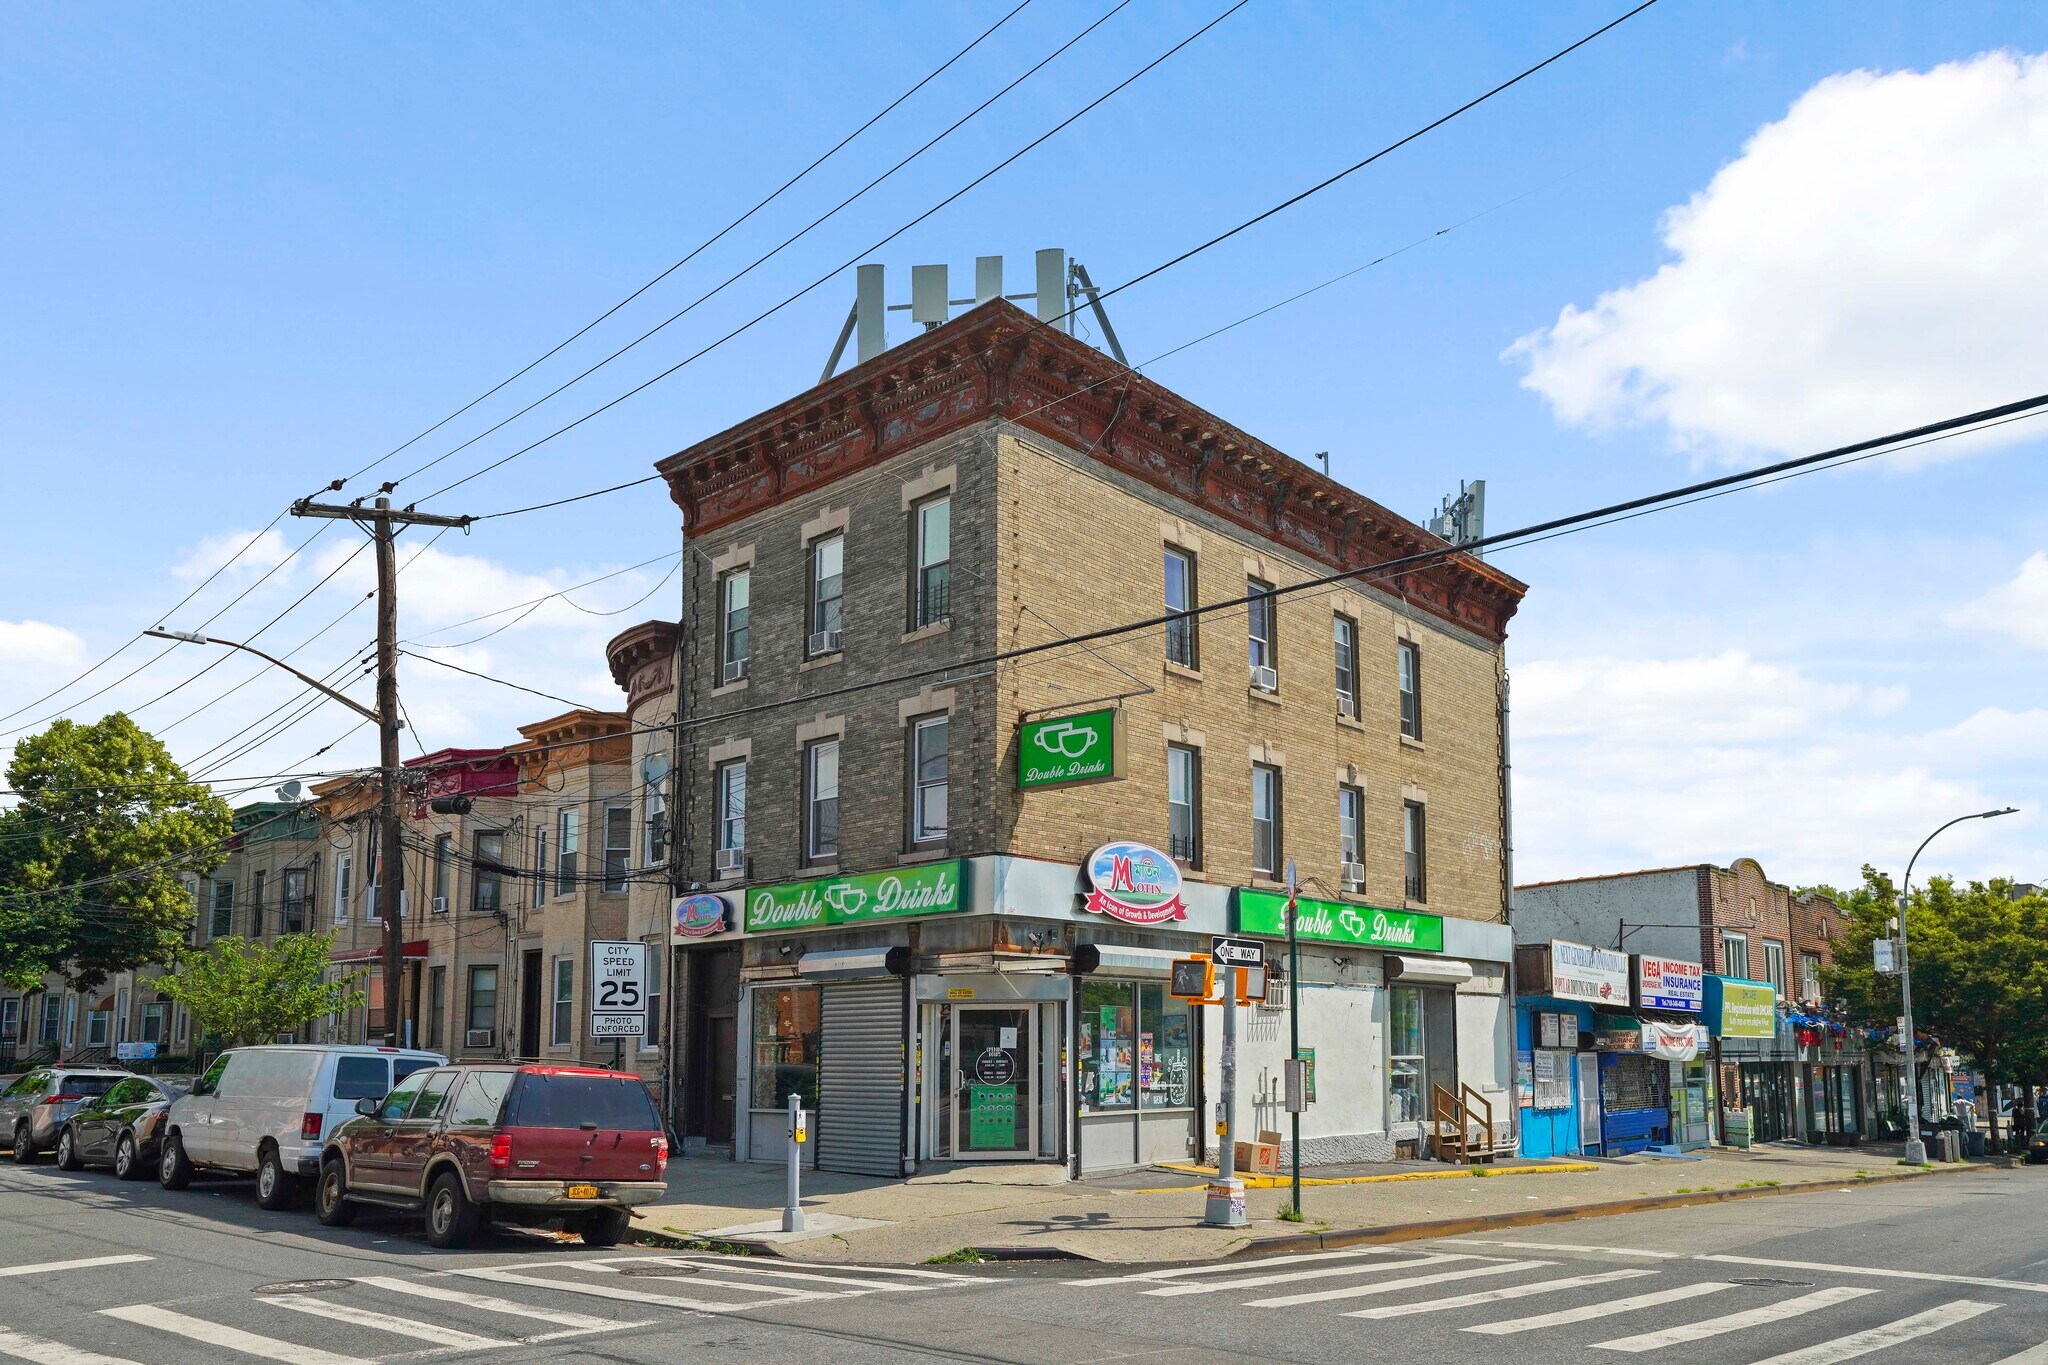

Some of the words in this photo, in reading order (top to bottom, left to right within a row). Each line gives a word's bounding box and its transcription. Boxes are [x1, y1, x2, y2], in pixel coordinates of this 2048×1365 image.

[1025, 765, 1065, 782] Double
[1066, 759, 1105, 776] Drinks
[749, 889, 823, 926] Double
[872, 872, 956, 914] Drinks
[1099, 895, 1107, 906] An
[1106, 898, 1118, 913] Icon
[1125, 908, 1143, 920] Growth
[1148, 903, 1177, 920] Development
[1371, 913, 1415, 944] Drinks
[607, 946, 630, 955] CITY
[1220, 946, 1234, 958] ONE
[1241, 949, 1256, 959] WAY
[603, 957, 635, 966] SPEED
[1642, 959, 1661, 979] VEGA
[1663, 961, 1688, 975] INCOME
[1689, 965, 1700, 977] TAX
[606, 968, 632, 977] LIMIT
[1663, 976, 1701, 991] INSURANCE
[599, 980, 640, 1006] 25
[1731, 1003, 1752, 1017] Registration
[1752, 1004, 1760, 1015] with
[604, 1017, 633, 1025] PHOTO
[596, 1025, 641, 1033] ENFORCED
